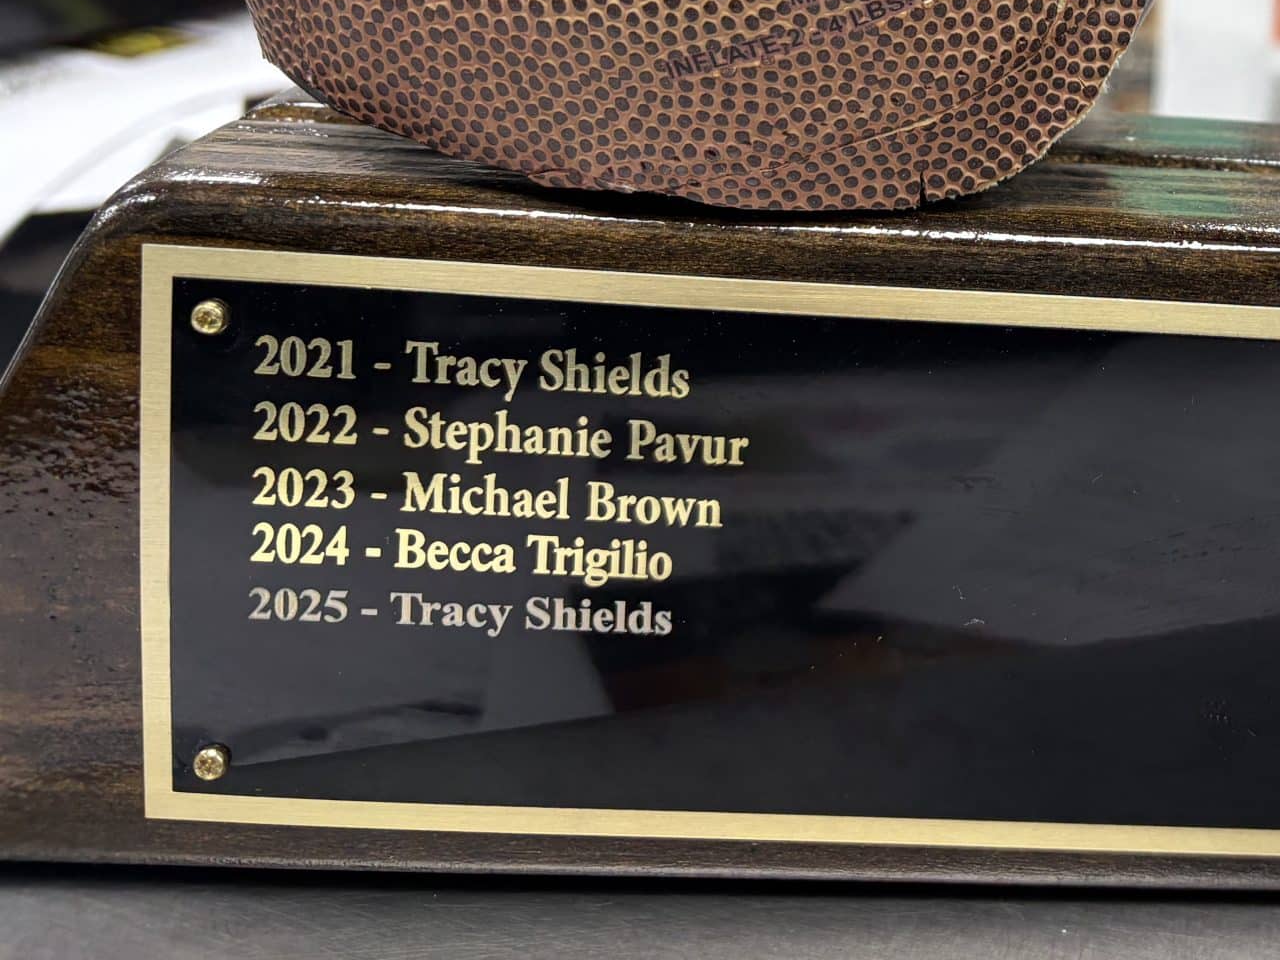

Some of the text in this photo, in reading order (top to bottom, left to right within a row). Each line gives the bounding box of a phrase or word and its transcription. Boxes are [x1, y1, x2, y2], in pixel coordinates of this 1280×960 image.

[254, 335, 356, 379] 2021
[405, 340, 528, 402] Tracy
[539, 349, 691, 399] Shields
[253, 401, 358, 445] 2022
[403, 406, 613, 464] Stephanie
[626, 420, 749, 466] Pavur
[251, 467, 356, 509] 2023
[400, 472, 571, 521] Michael
[585, 481, 723, 528] Brown
[249, 523, 350, 566] 2024
[394, 528, 516, 574] Becca
[527, 534, 673, 587] Trigilio
[248, 588, 349, 623] 2025
[389, 592, 513, 638] Tracy
[525, 597, 673, 636] Shields
